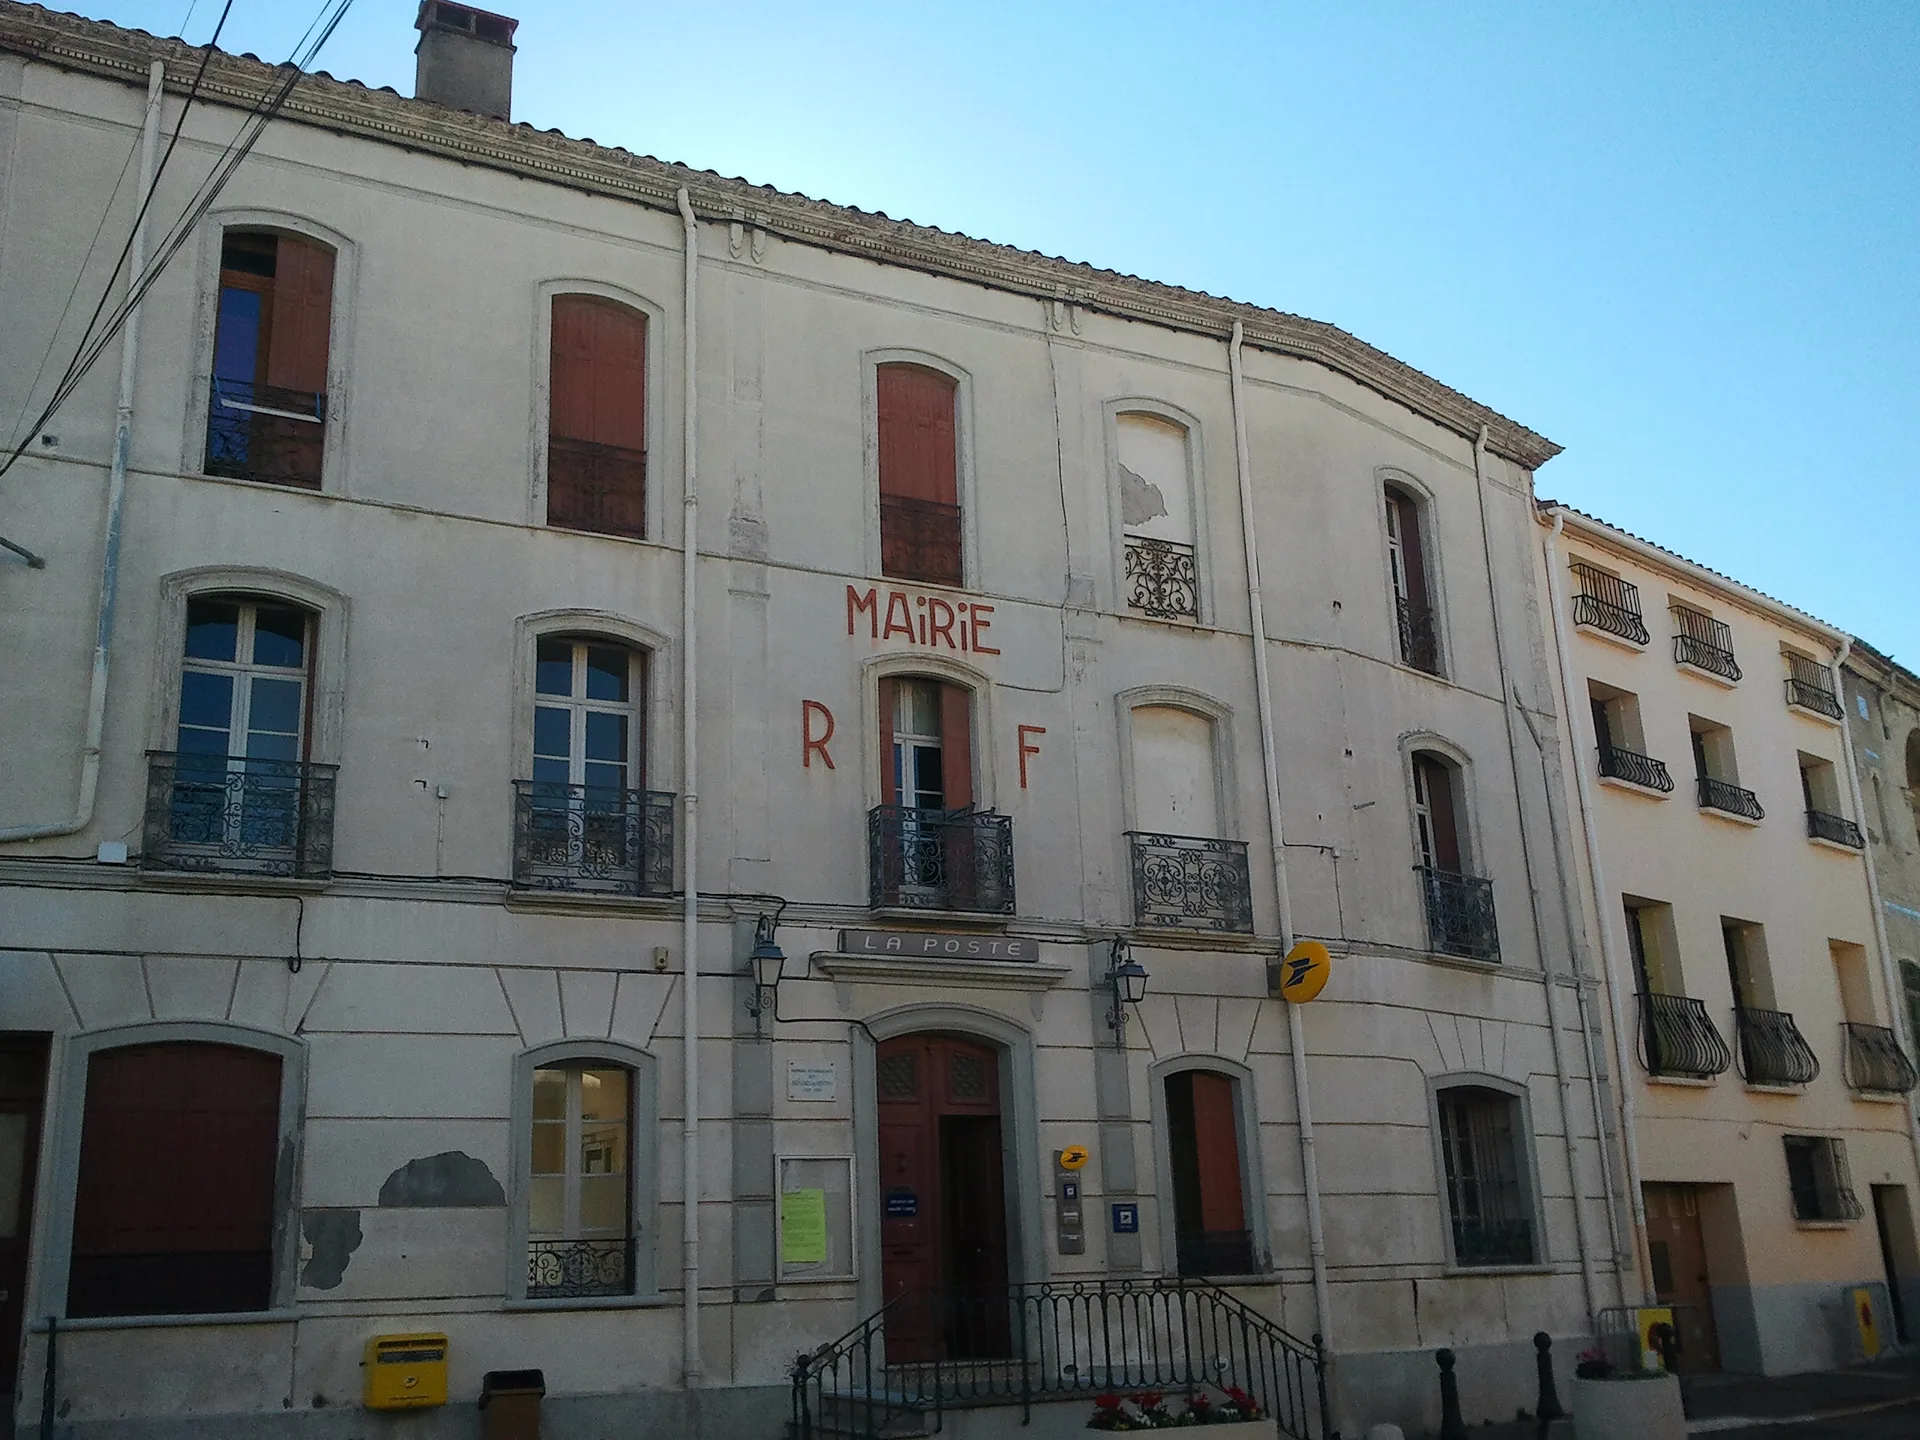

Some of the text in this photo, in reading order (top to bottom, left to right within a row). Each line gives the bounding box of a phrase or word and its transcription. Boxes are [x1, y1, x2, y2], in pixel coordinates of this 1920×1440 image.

[802, 700, 1046, 788] R F
[864, 935, 1022, 956] LA POSTE
